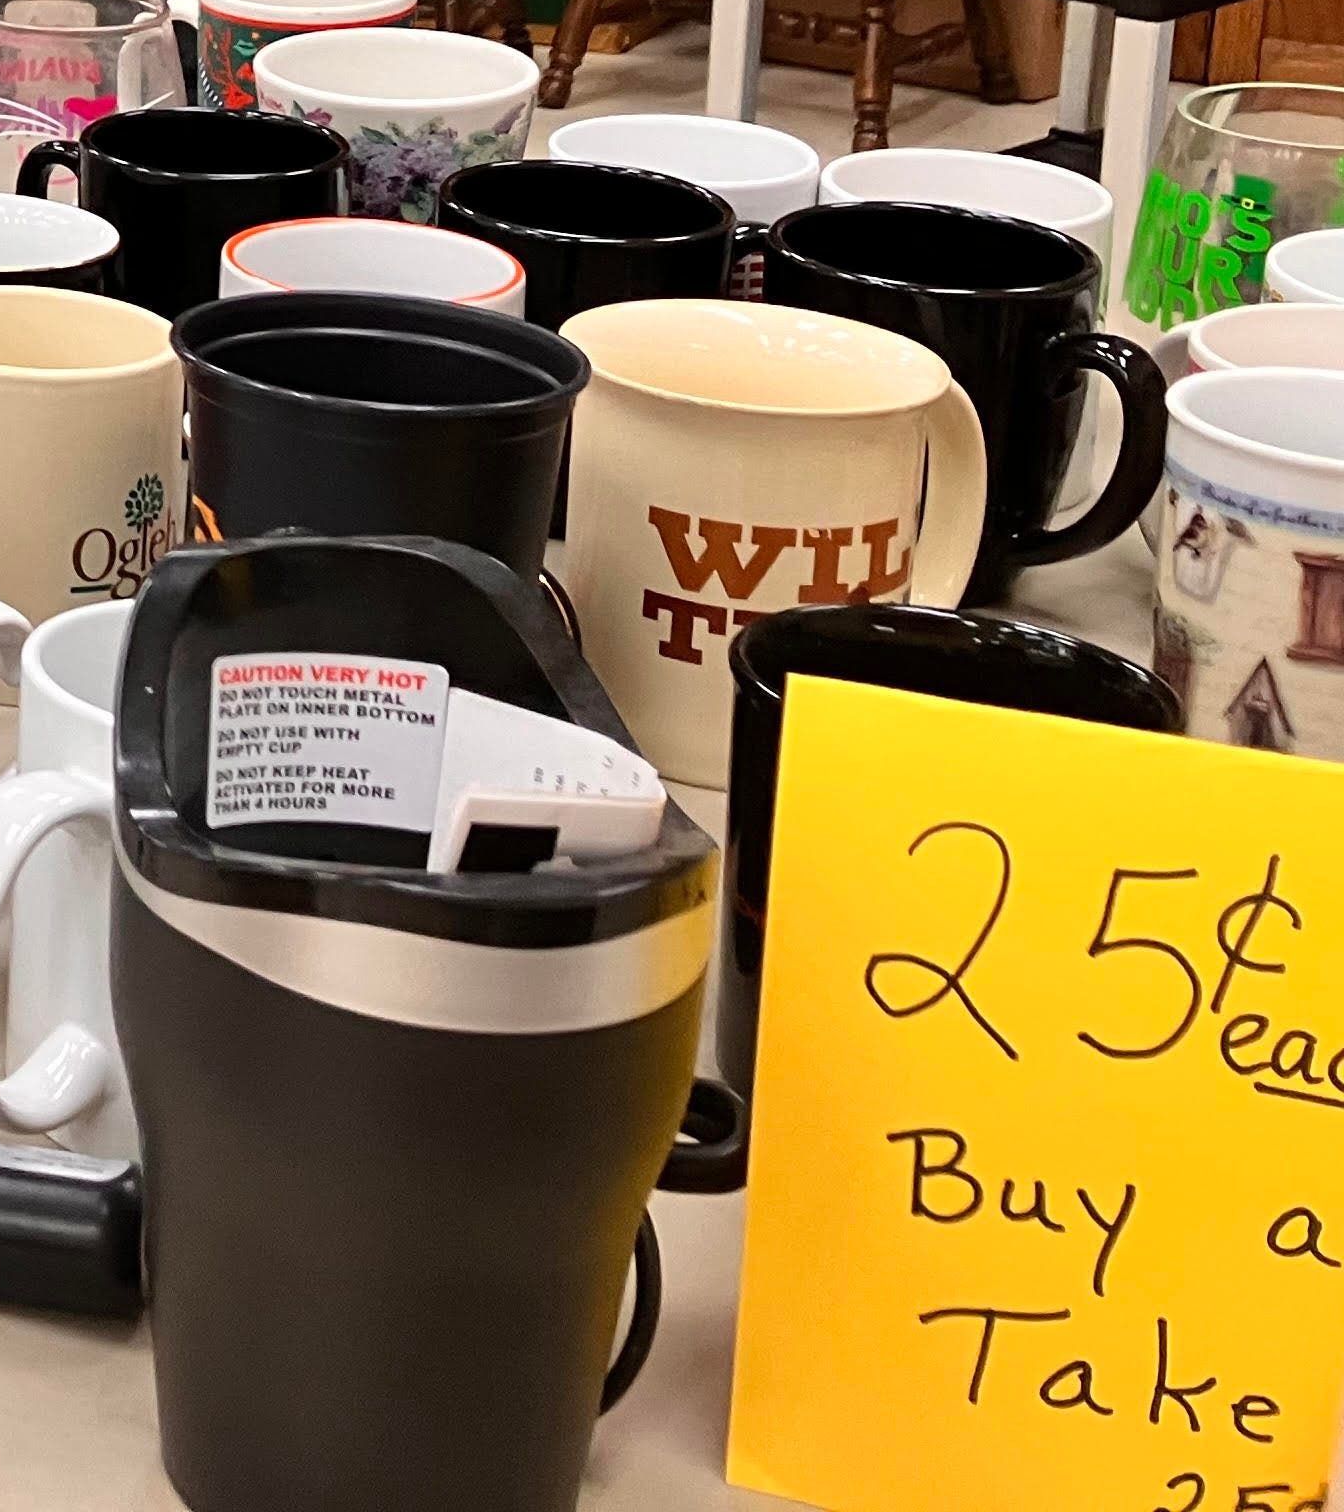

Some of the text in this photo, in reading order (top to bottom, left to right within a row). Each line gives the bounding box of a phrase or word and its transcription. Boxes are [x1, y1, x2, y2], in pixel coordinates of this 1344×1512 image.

[219, 665, 427, 690] CAUTION VERY HOT
[219, 688, 406, 706] DO NOT TOUCH METAL
[218, 702, 435, 727] PLATE ON INNER BOTTOM
[217, 726, 360, 743] DO NOT USE WITH
[216, 741, 303, 759] EMPTY CUP
[216, 765, 370, 784] DO NOT KEEP HEAT
[215, 782, 396, 800] ACTIVATED FOR MORE
[214, 797, 327, 816] THAN 4 HOURS
[864, 820, 1303, 1061] 25¢
[886, 1127, 1343, 1297] Buy a
[918, 1308, 1282, 1444] Take
